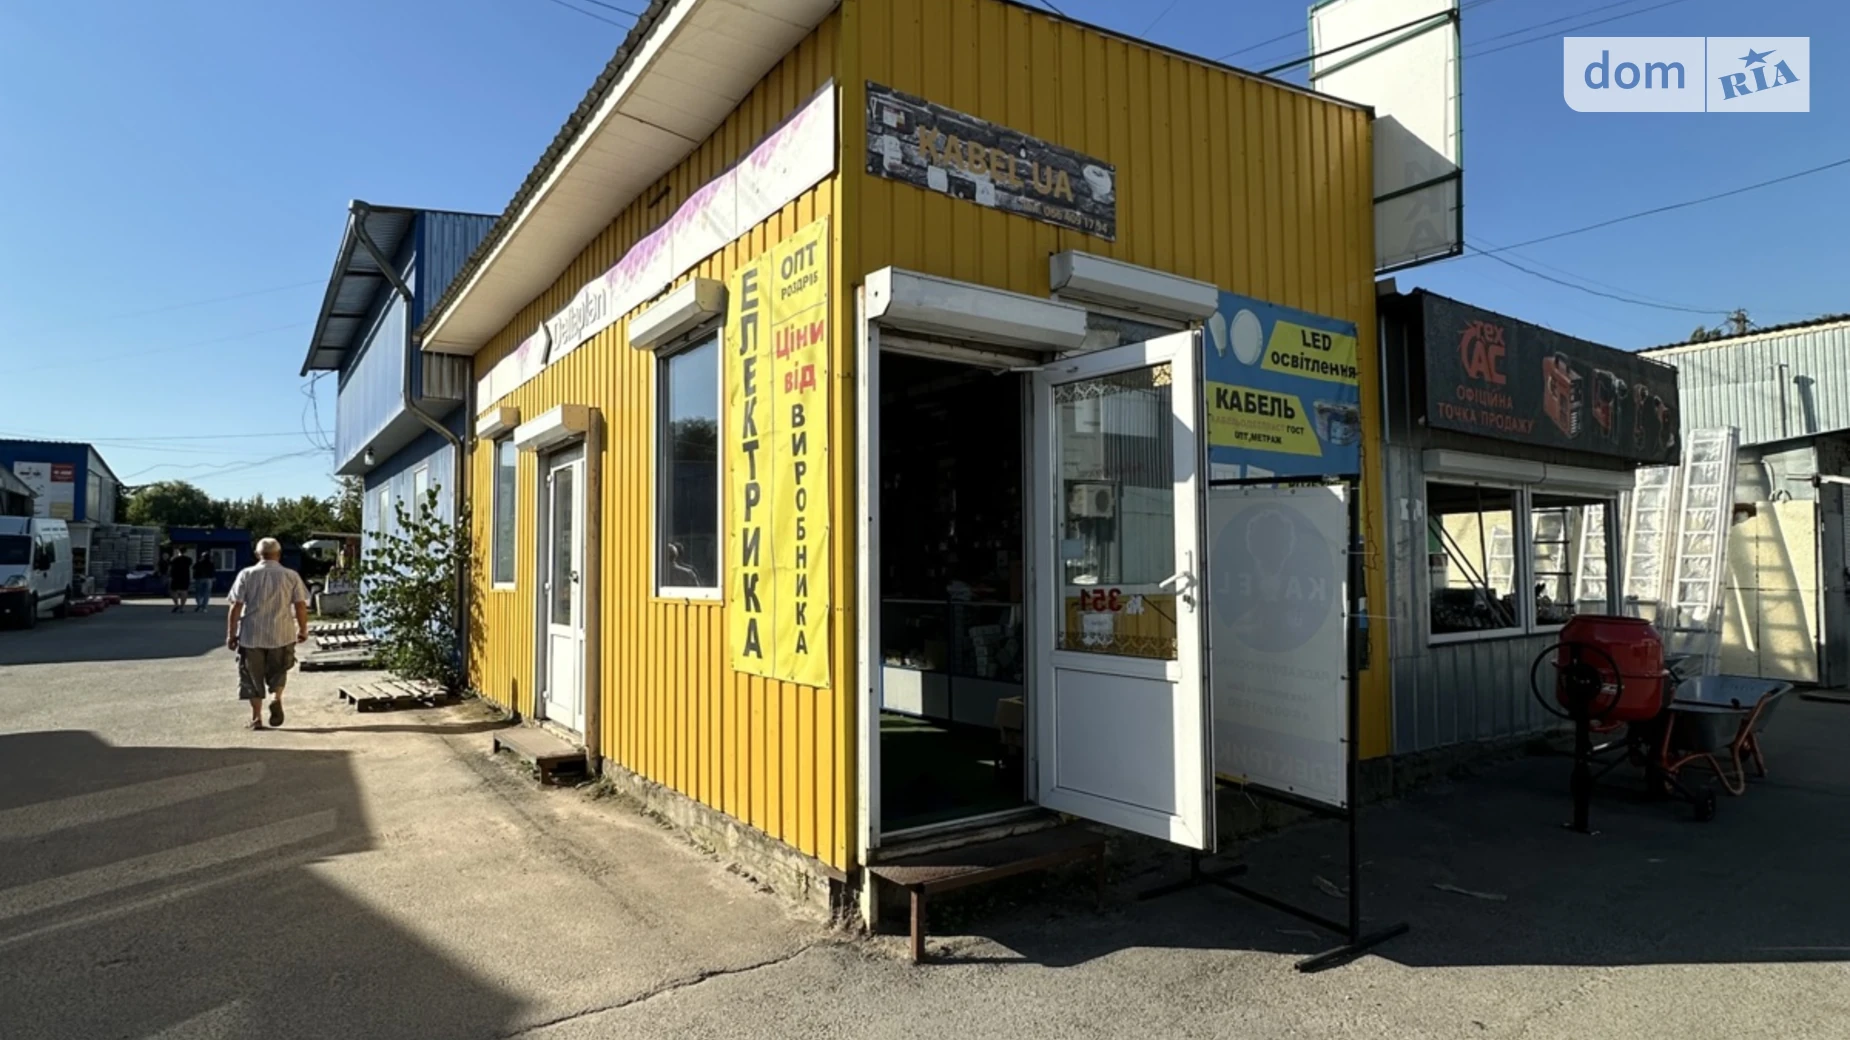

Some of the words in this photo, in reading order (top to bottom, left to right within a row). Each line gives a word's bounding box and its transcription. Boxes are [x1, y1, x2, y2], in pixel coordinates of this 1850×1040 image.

[918, 124, 1024, 188] KABEL
[1032, 161, 1074, 203] UA
[781, 239, 818, 280] ОПТ
[781, 271, 818, 300] РОЗДРІБ
[776, 319, 825, 361] Ціни
[1301, 329, 1332, 351] LED
[784, 361, 816, 395] від
[1271, 351, 1357, 379] освітлення
[1215, 387, 1296, 420] КАБЕЛЬ
[1438, 402, 1477, 424] ТОЧКА
[1481, 411, 1534, 434] ПРОДАЖУ
[739, 267, 763, 660] ЕЛЕКТРИКА
[791, 403, 808, 655] ВИРОБНИКА
